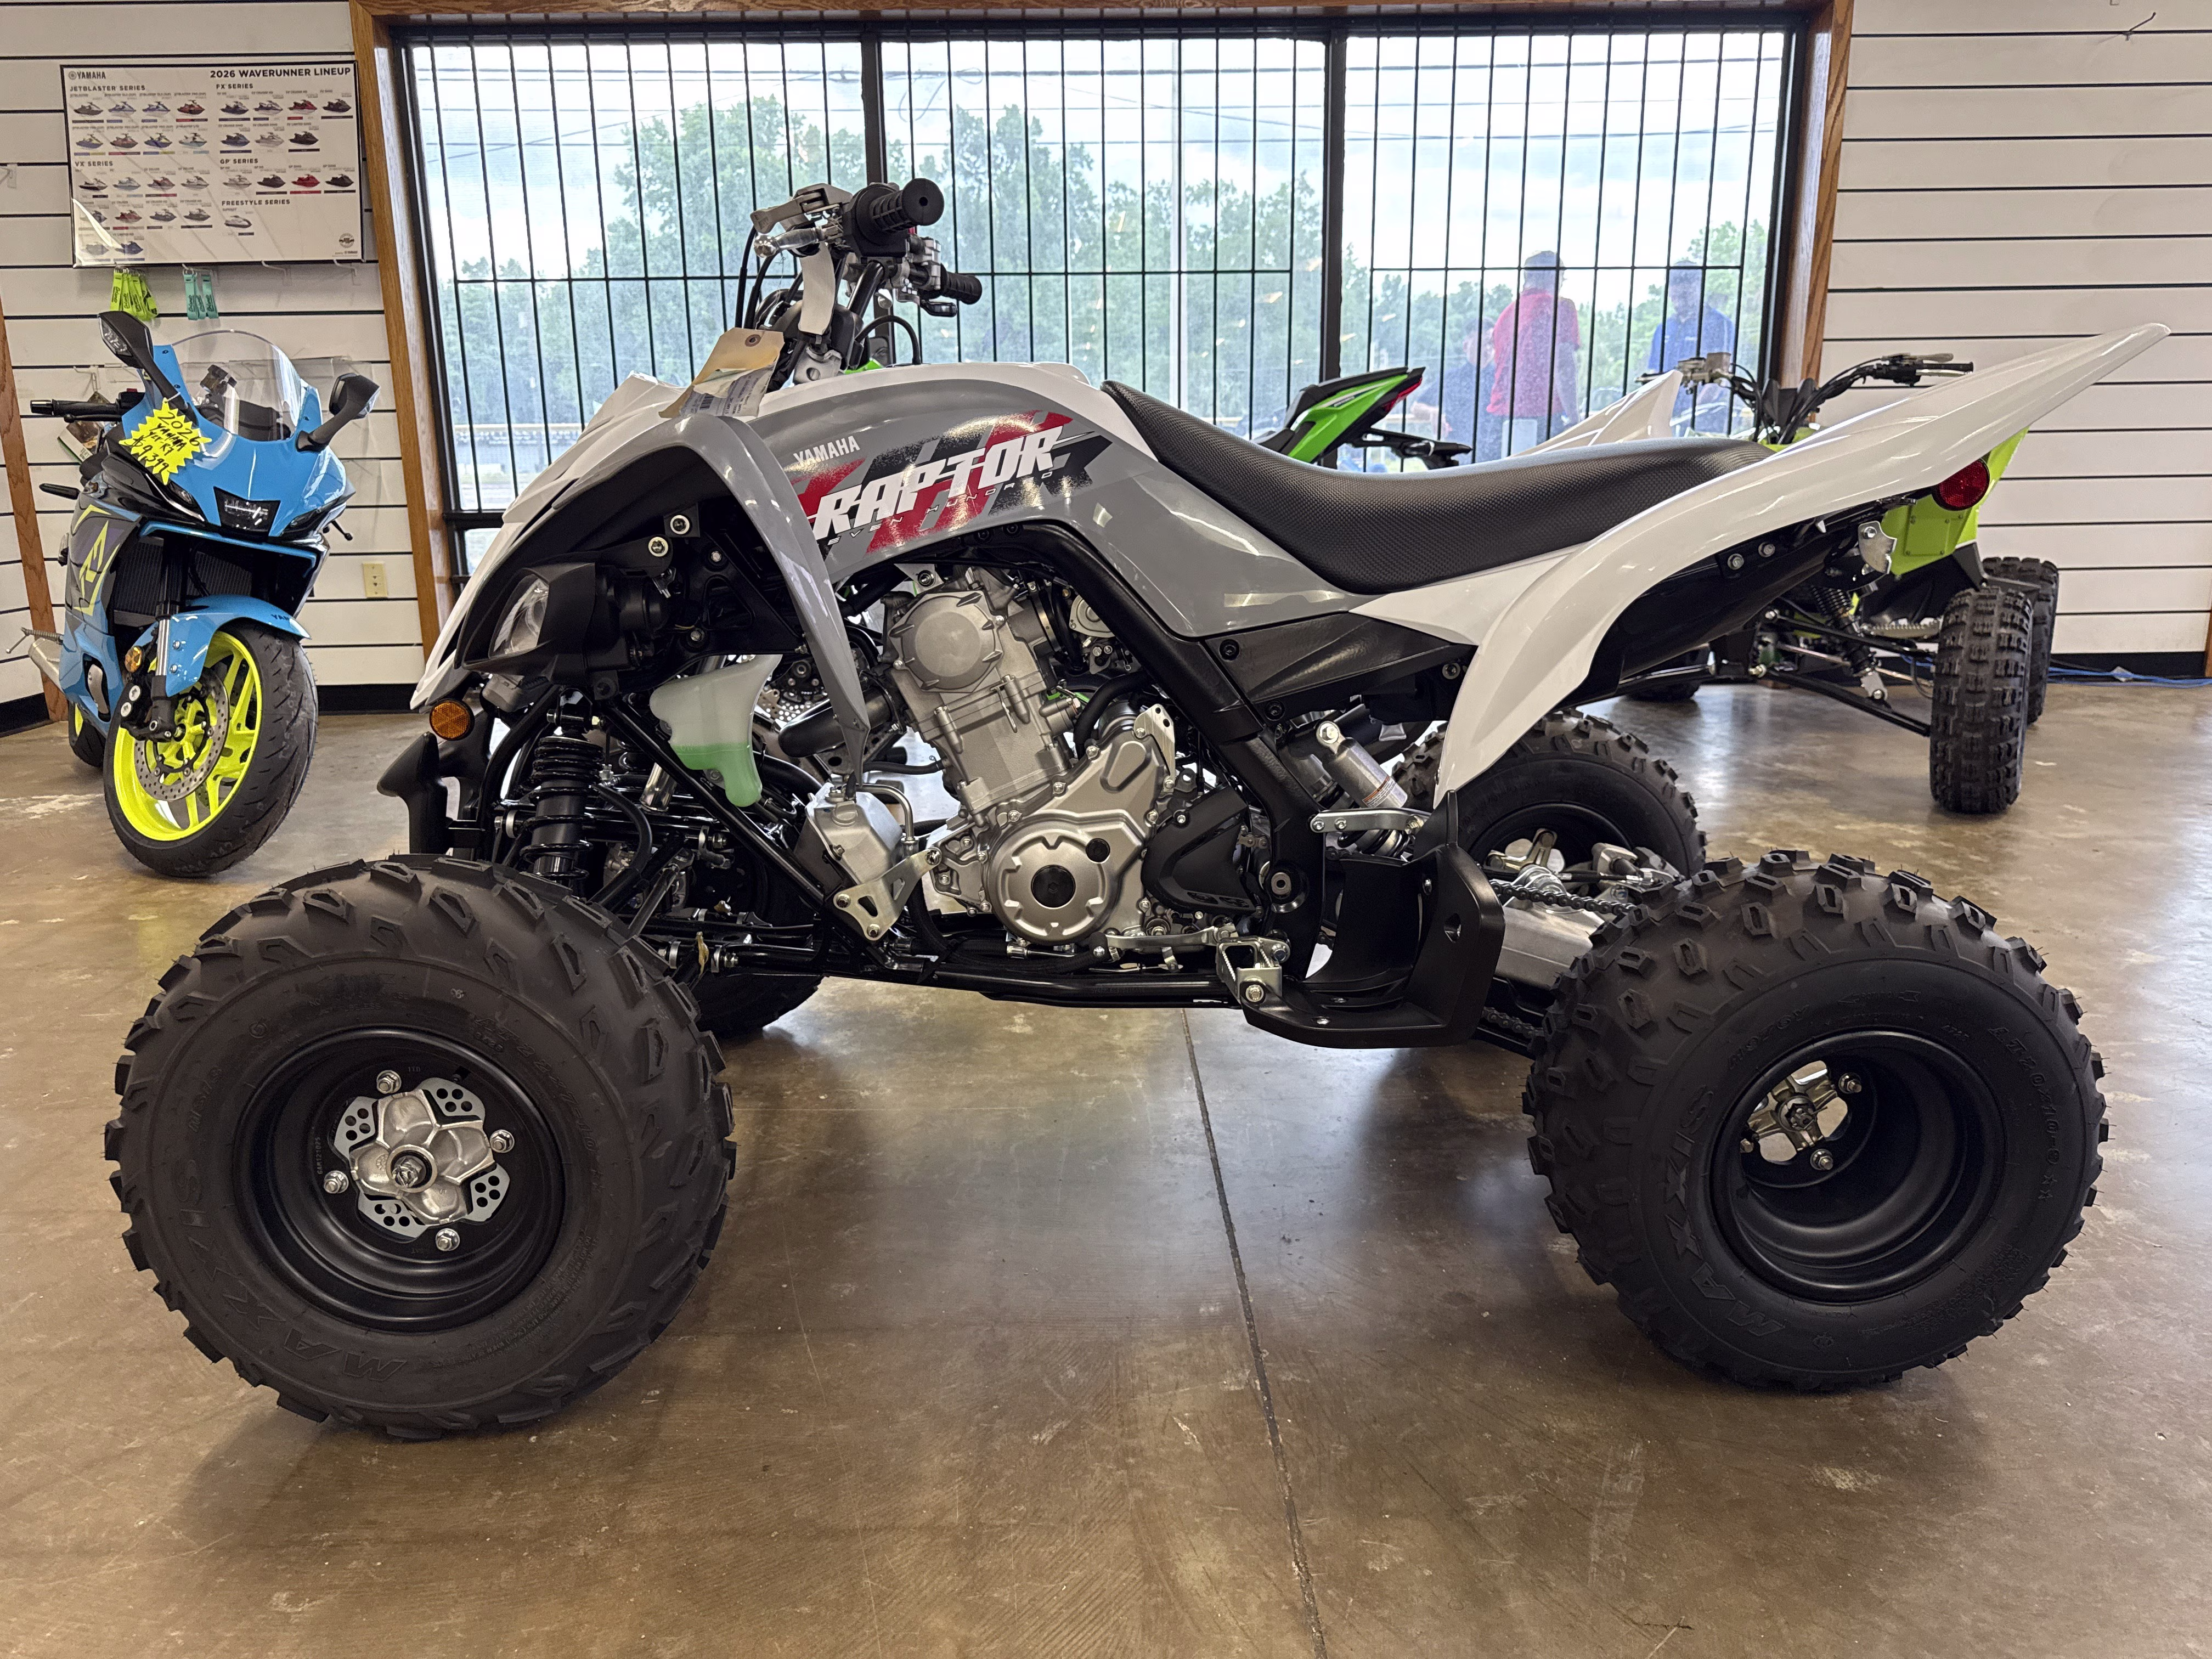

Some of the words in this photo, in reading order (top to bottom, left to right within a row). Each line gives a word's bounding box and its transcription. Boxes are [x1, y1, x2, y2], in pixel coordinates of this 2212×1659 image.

[76, 71, 106, 80] YAMAHA
[210, 70, 235, 78] 2026
[239, 68, 311, 78] WAVERUNNER
[314, 67, 351, 76] LINEUP
[149, 423, 187, 452] YAMAHA
[157, 411, 201, 446] 2026
[793, 436, 860, 467] YAMAHA
[809, 425, 1070, 540] RAPTOR
[827, 516, 904, 546] EVEN
[926, 471, 1053, 515] HUNDRED
[1663, 1085, 1786, 1338] MAXXIS
[172, 1159, 409, 1382] MAXXIS
